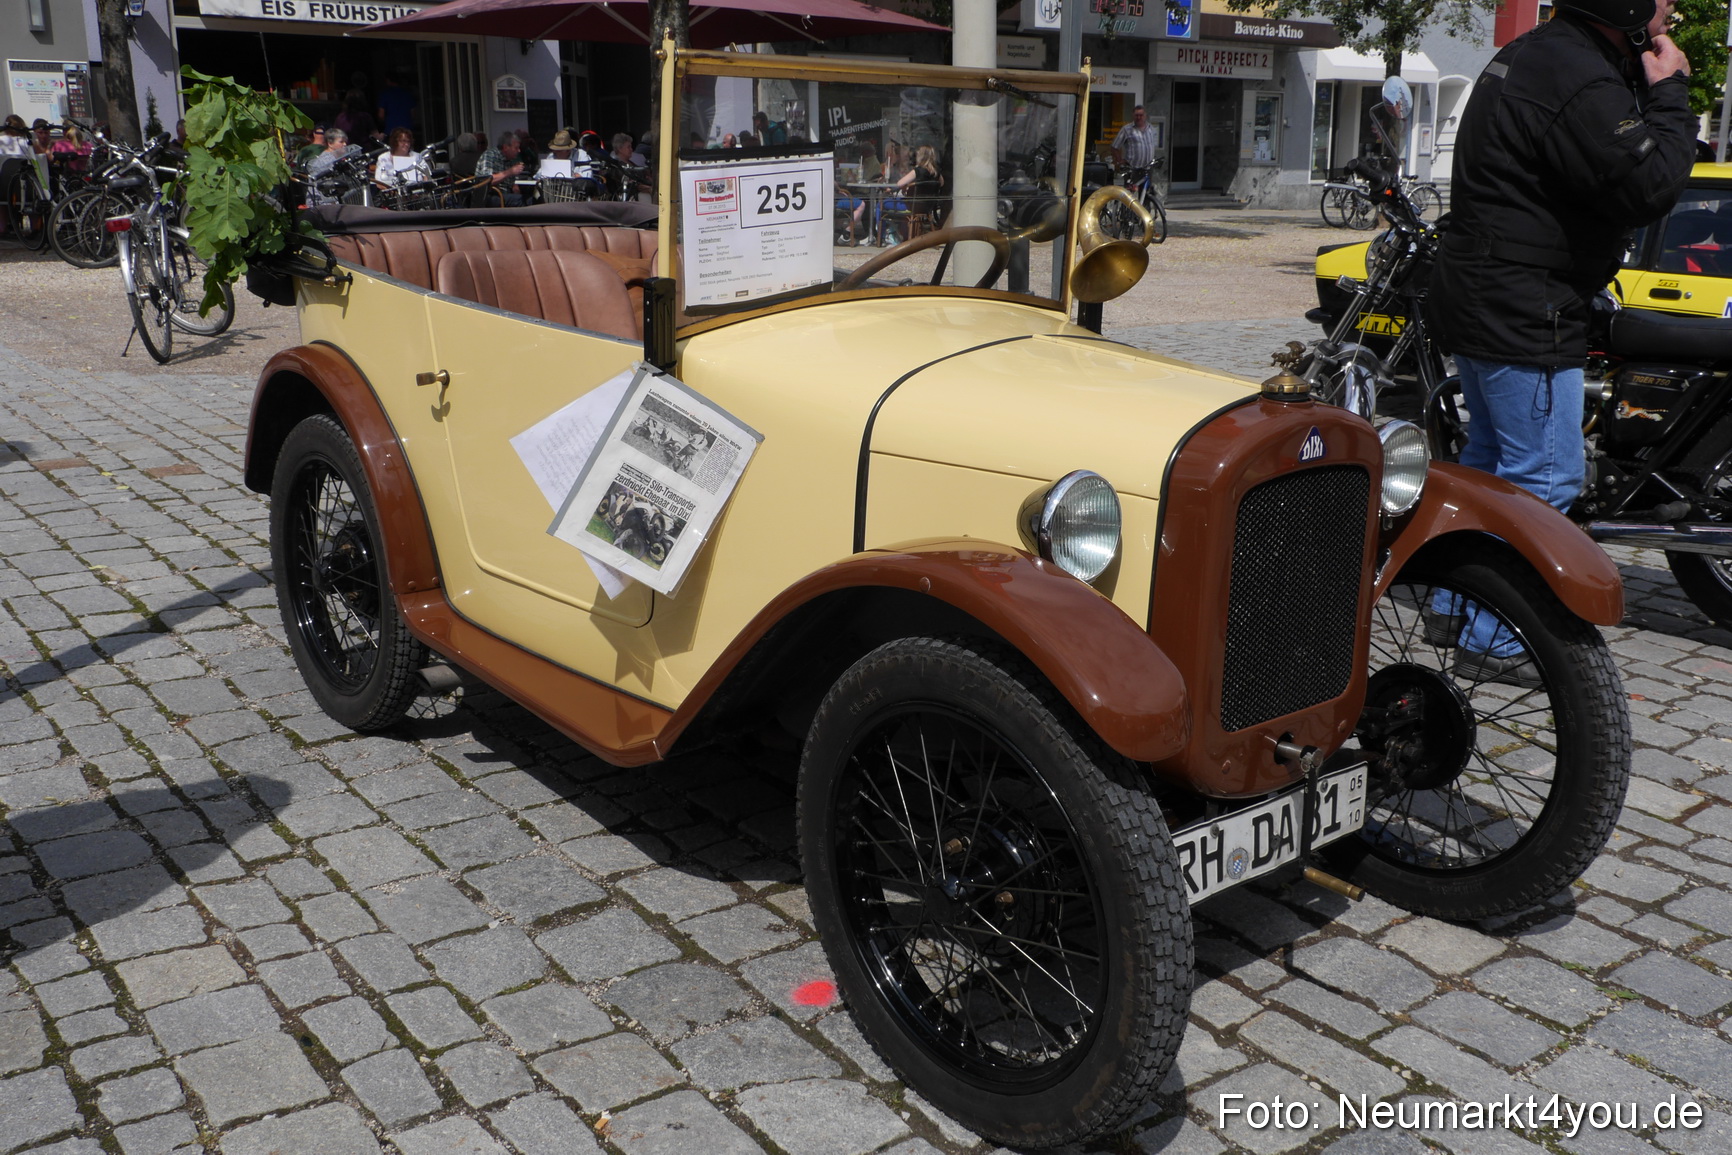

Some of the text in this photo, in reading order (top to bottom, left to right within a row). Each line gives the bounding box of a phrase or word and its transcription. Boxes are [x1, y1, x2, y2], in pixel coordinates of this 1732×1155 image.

[261, 0, 296, 17] EIS
[1178, 48, 1268, 68] PITCH PERFECT 2
[1200, 65, 1233, 75] MAD MAX
[828, 105, 851, 127] IPL
[834, 136, 856, 148] TUDIO"
[757, 182, 807, 215] 255
[1632, 375, 1671, 386] TIGER 750
[1301, 435, 1323, 460] DIXI
[614, 473, 692, 521] zerdrückt Ehepaar im Dixi
[649, 480, 696, 512] Silo-Transporter
[1350, 774, 1363, 792] 05
[1349, 808, 1361, 826] 10
[1174, 829, 1224, 895] RH
[1252, 803, 1295, 870] DA
